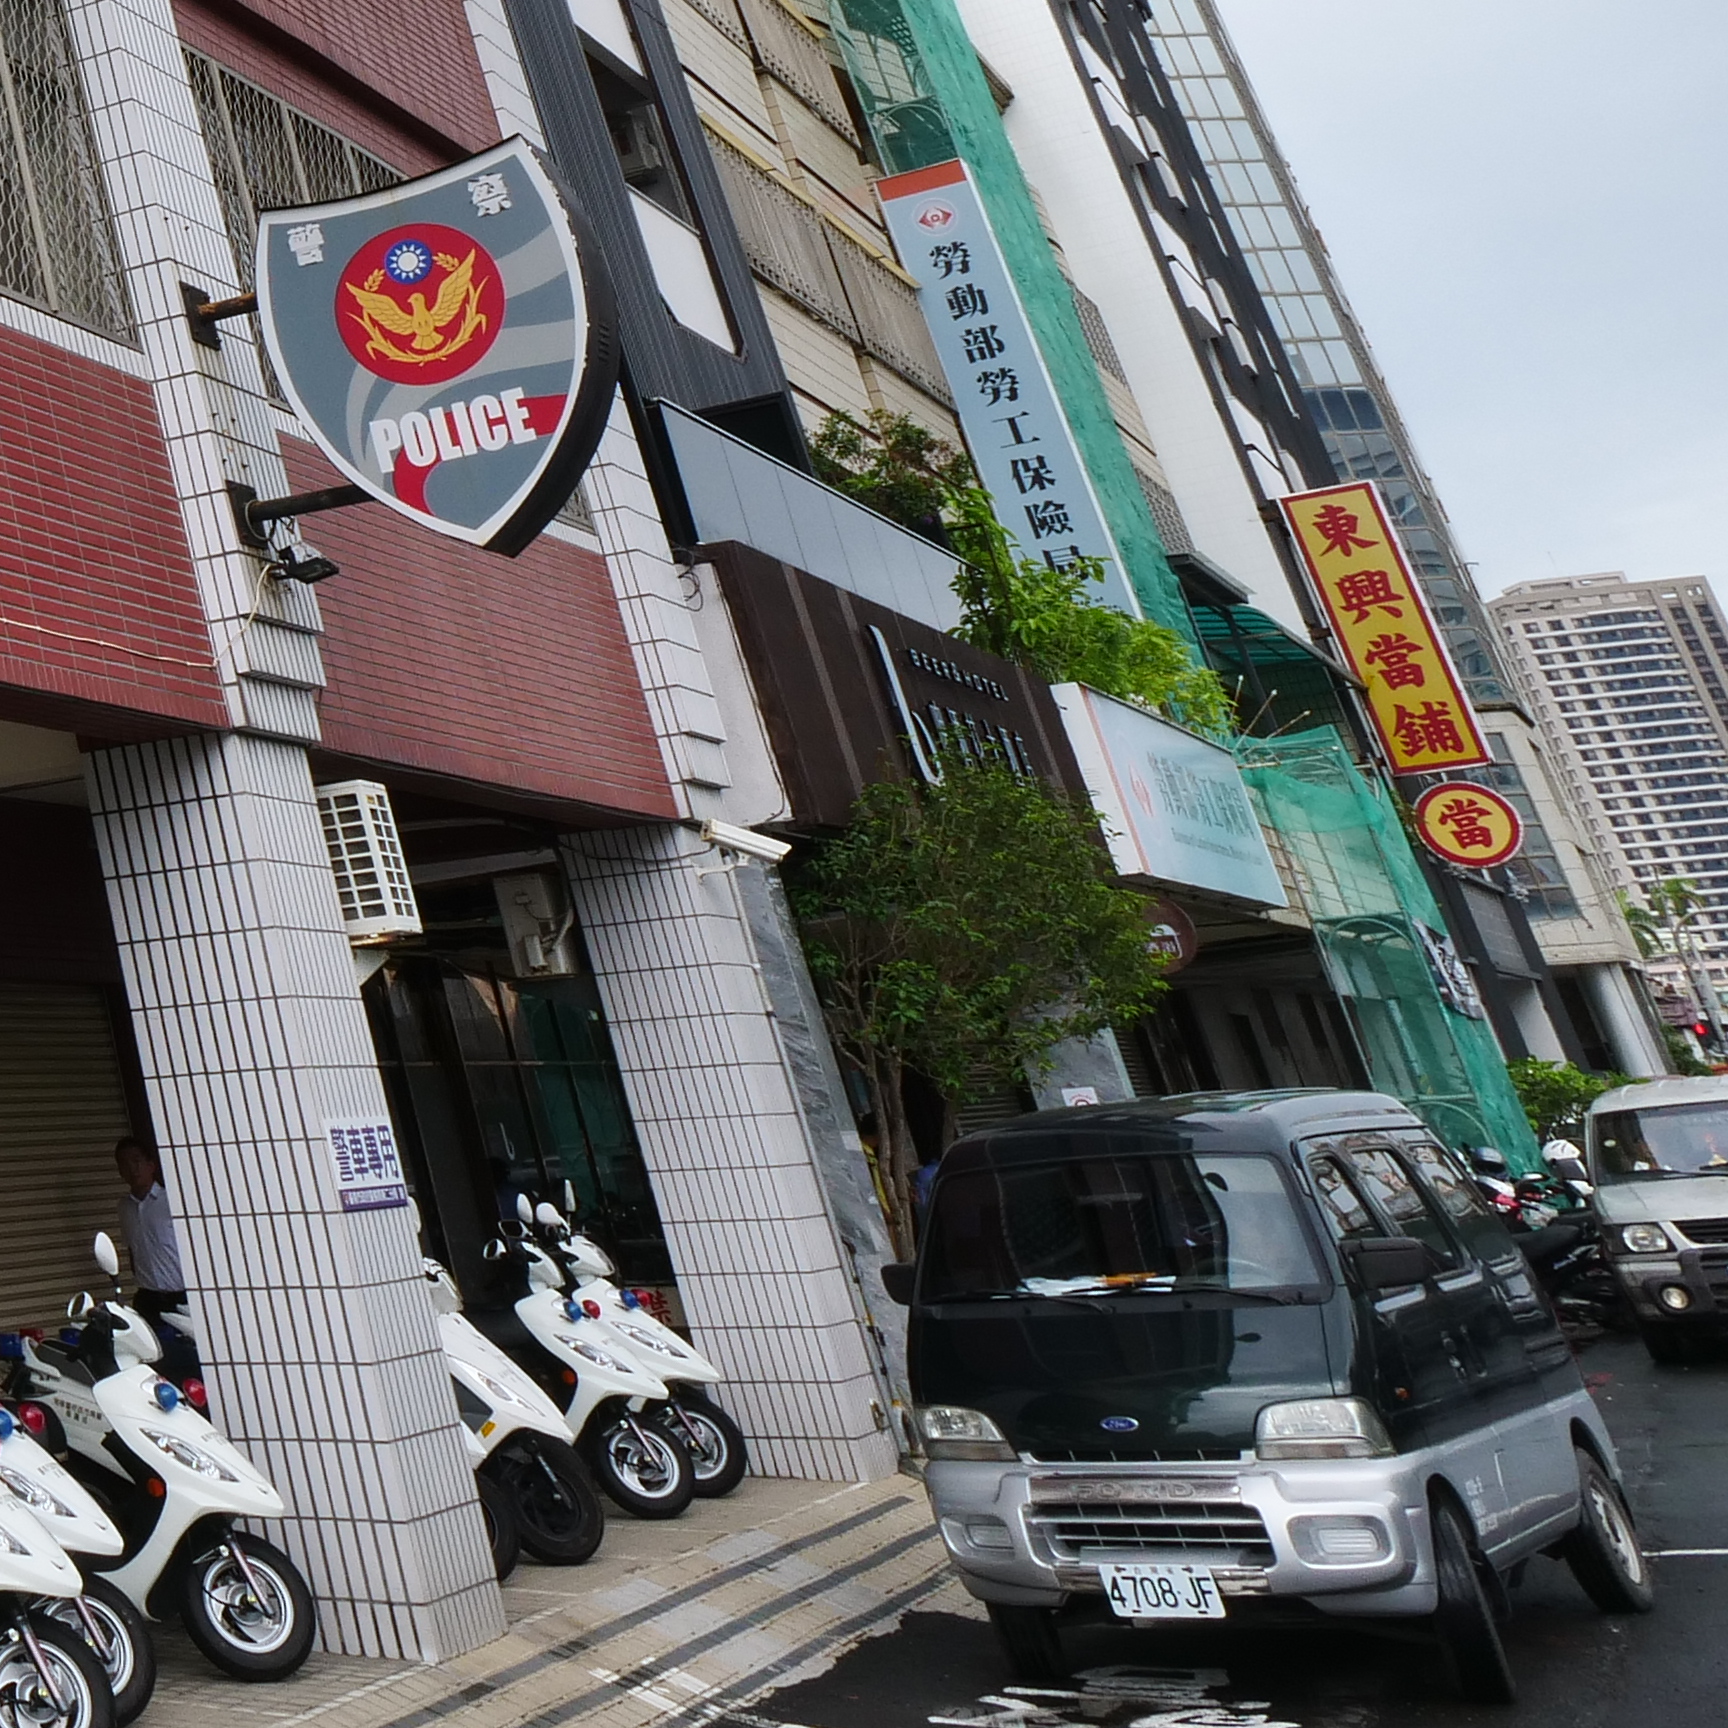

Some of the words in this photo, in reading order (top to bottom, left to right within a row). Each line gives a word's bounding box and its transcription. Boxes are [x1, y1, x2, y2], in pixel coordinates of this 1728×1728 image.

[368, 386, 538, 473] POLICE
[1311, 503, 1466, 758] 東興當鋪
[1438, 797, 1511, 850] 當
[329, 1123, 401, 1182] 警車專用
[1072, 1481, 1196, 1500] FORD
[1110, 1576, 1214, 1610] 4708-JF
